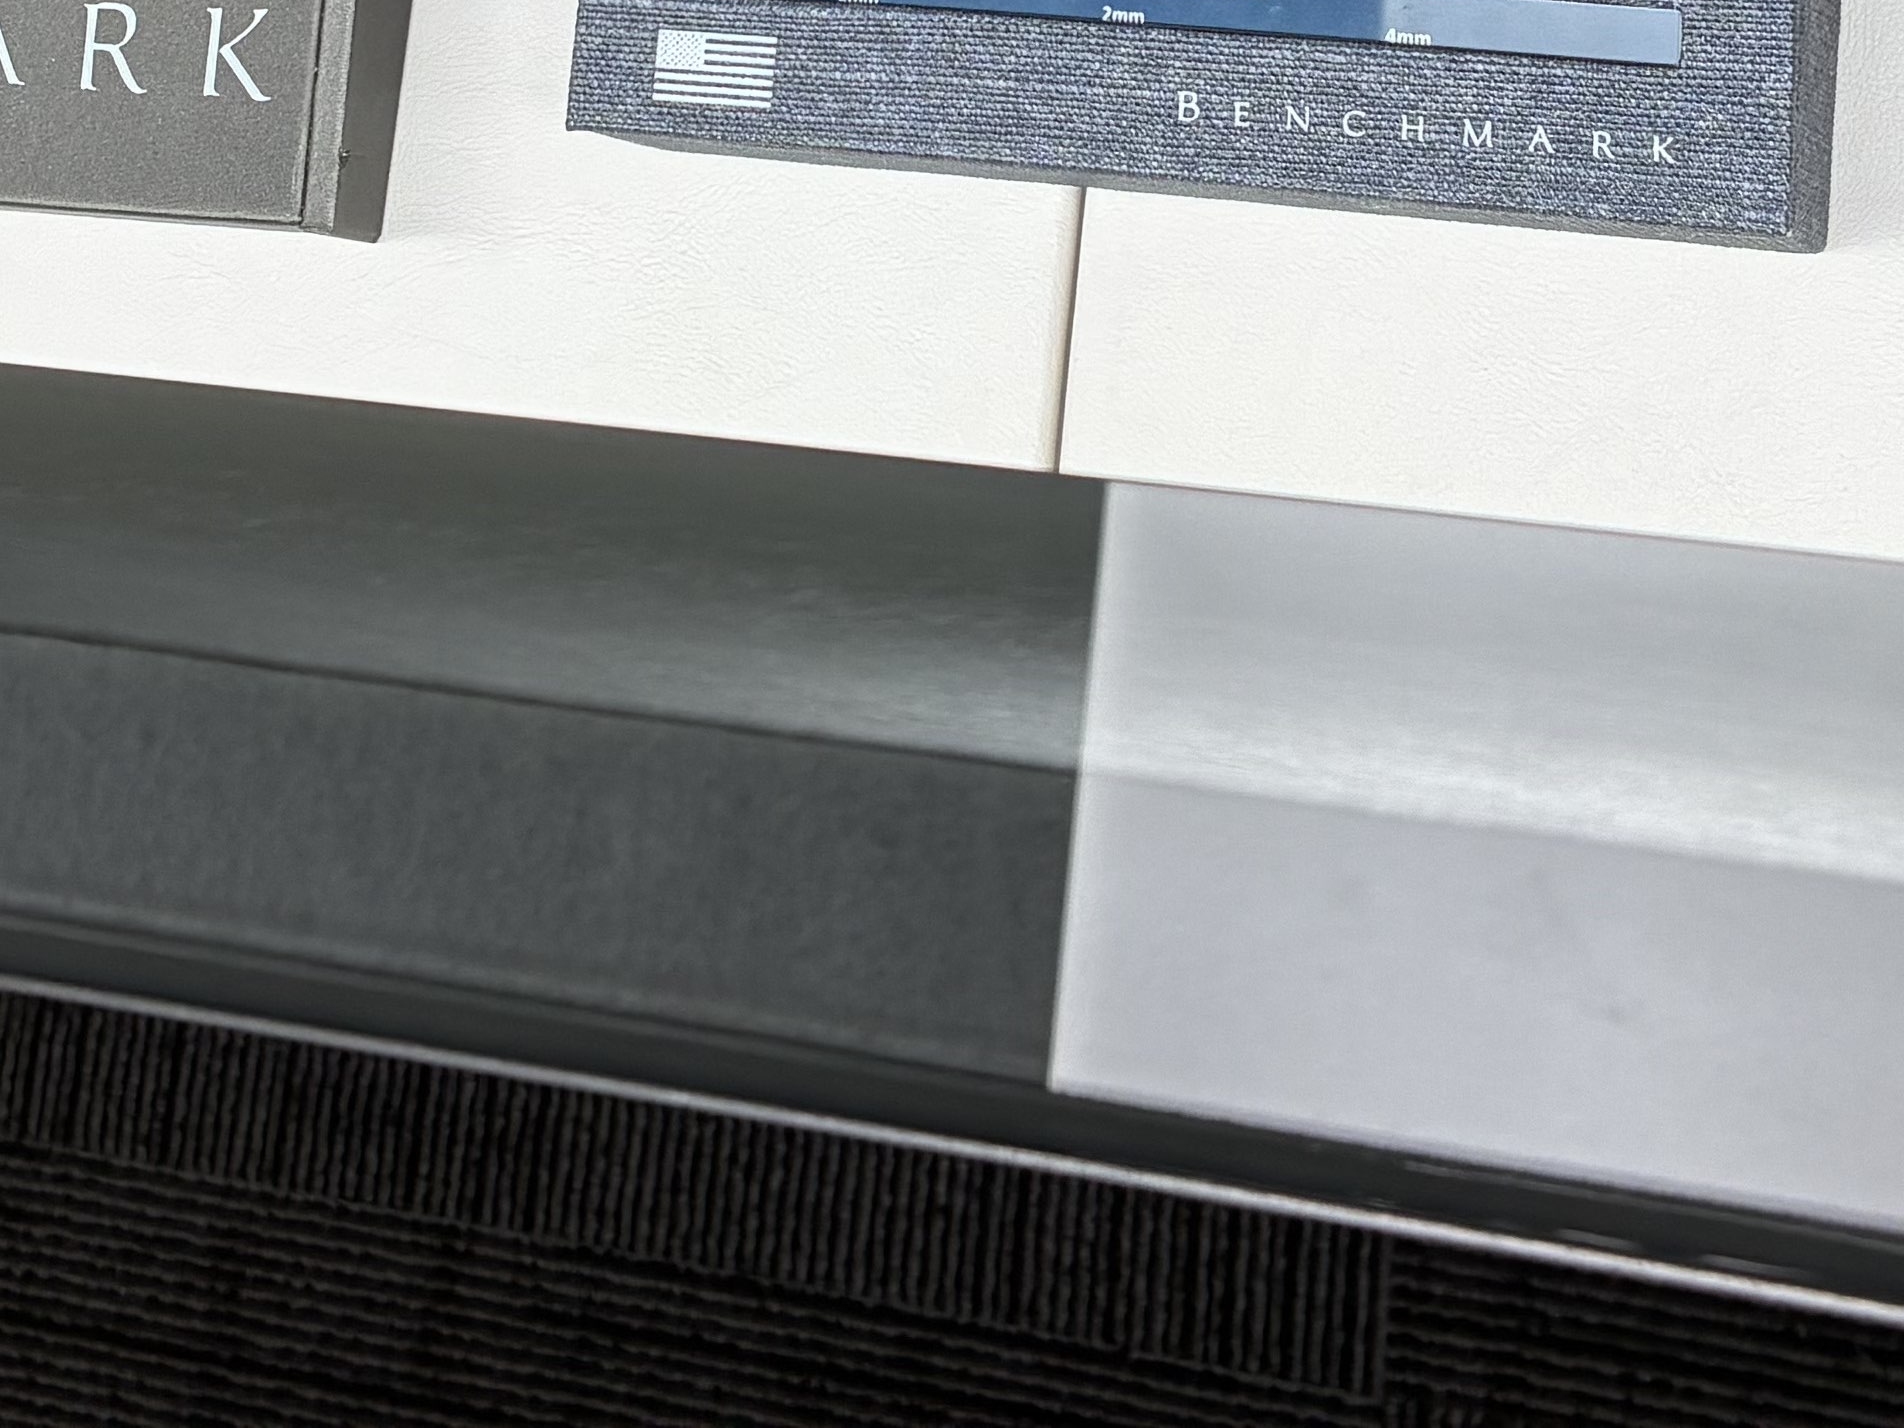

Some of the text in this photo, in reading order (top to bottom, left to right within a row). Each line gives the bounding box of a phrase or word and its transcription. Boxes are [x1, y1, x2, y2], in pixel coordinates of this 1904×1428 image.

[1102, 5, 1145, 24] 2mm
[1384, 27, 1432, 46] 4mm
[1177, 90, 1676, 164] BENCHMARK
